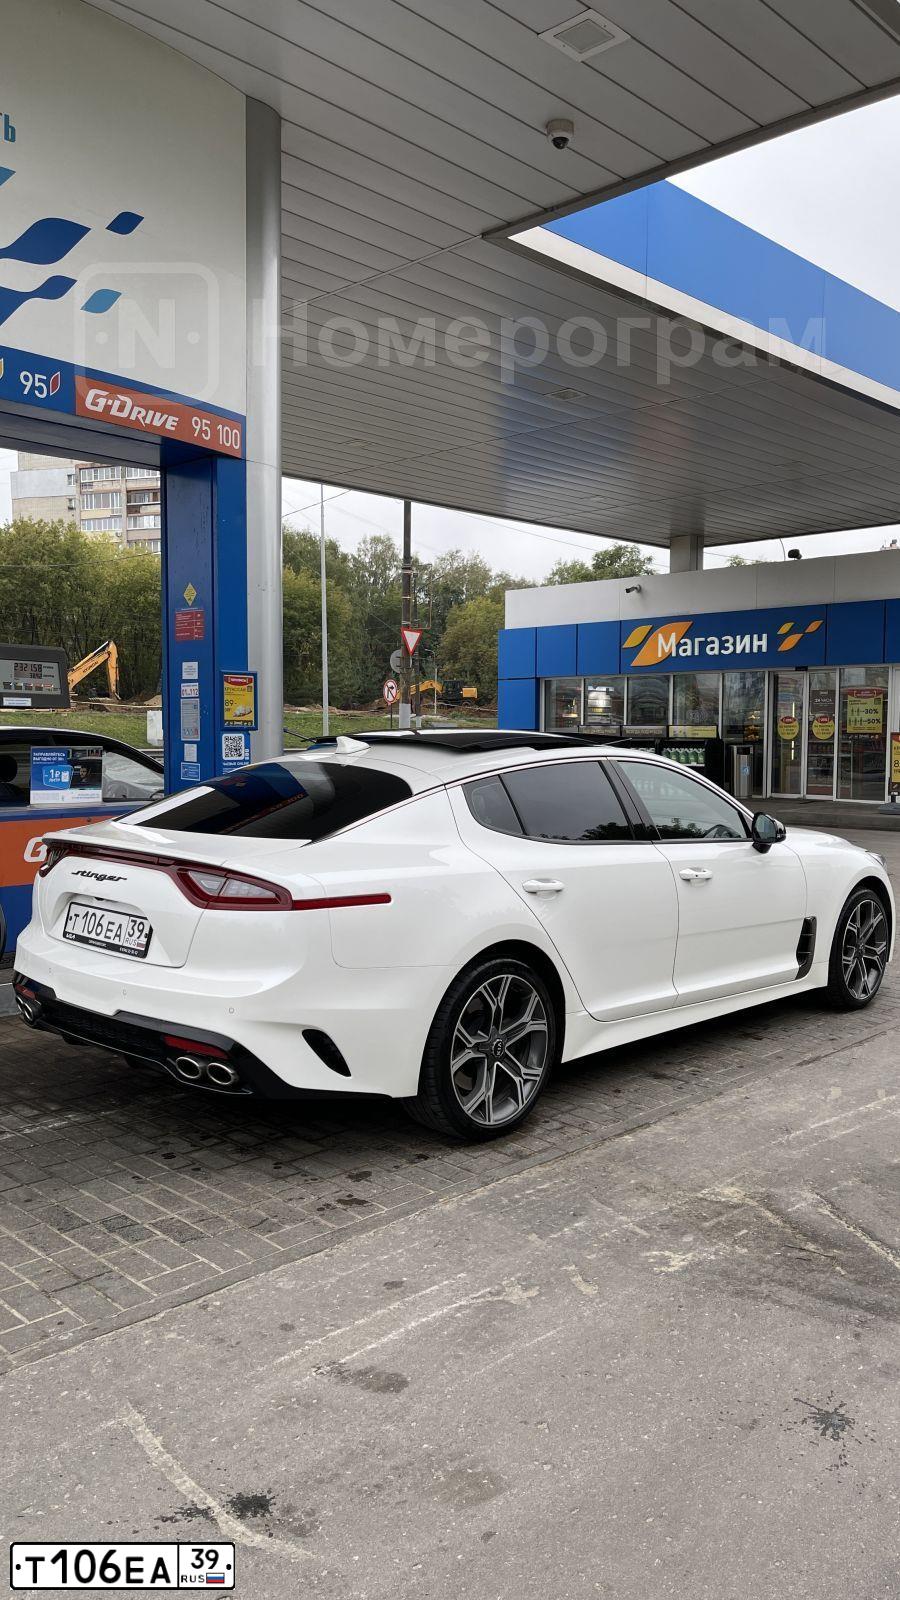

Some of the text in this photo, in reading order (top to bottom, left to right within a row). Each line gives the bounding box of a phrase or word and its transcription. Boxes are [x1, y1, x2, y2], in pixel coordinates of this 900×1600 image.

[19, 370, 48, 399] 95
[191, 416, 212, 441] 95
[217, 424, 241, 450] 100
[657, 632, 768, 658] Магазин
[71, 869, 128, 882] stinger
[72, 910, 145, 943] Т106ЕА 39
[125, 937, 137, 946] RUS
